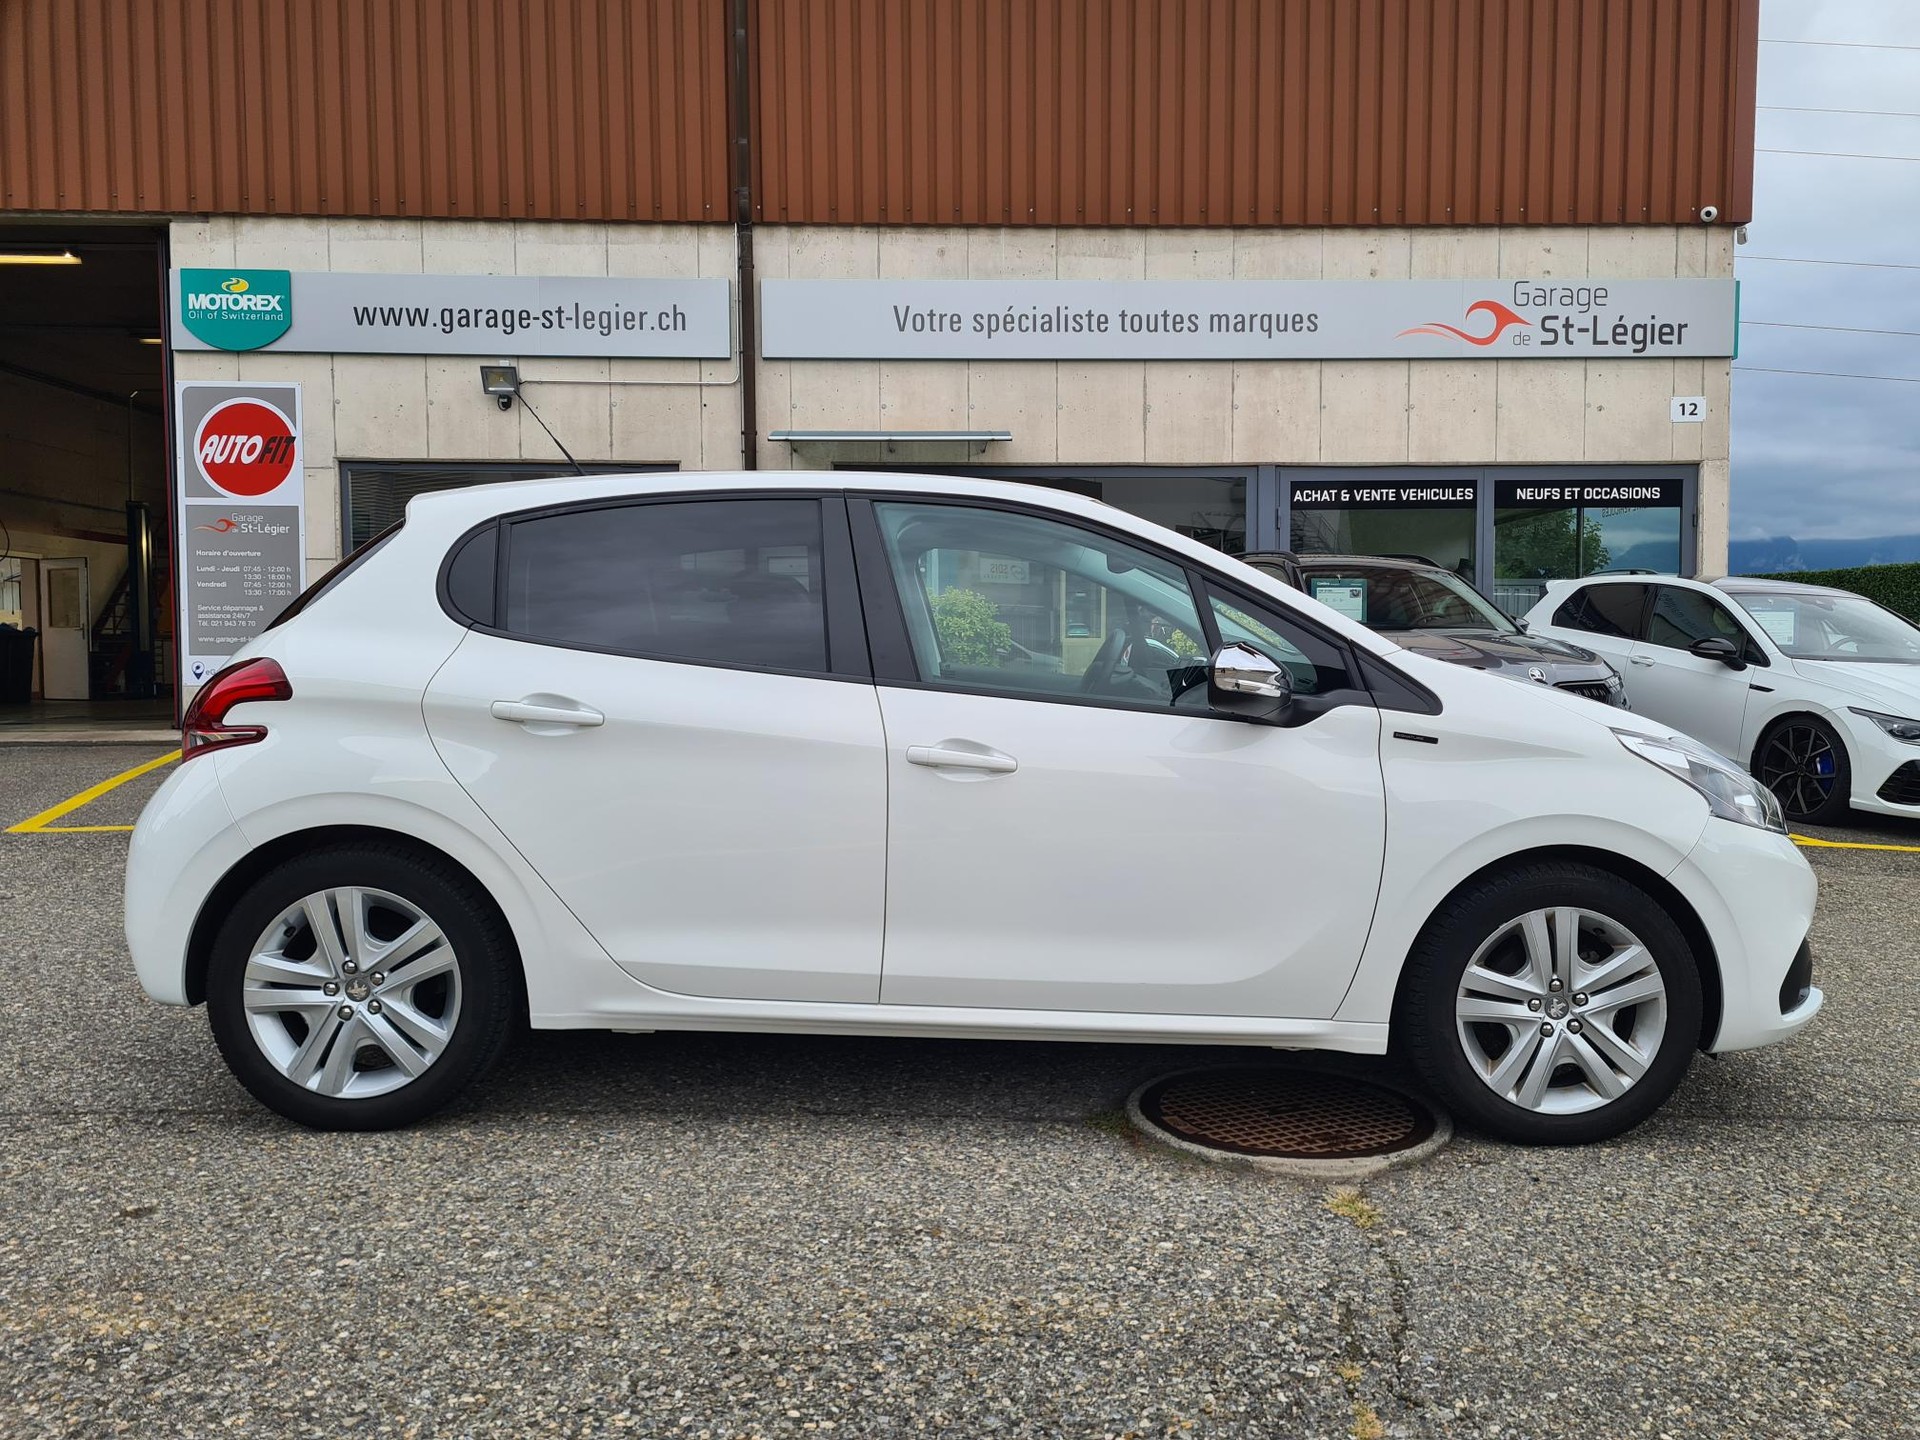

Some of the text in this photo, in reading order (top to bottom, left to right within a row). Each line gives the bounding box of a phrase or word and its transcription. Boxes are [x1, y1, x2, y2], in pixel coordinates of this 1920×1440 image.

[188, 293, 283, 312] MOTOREX
[1512, 280, 1608, 314] Garage
[188, 310, 284, 321] Oil of Switzerland
[352, 302, 687, 336] www.garage-st-legier.ch
[893, 305, 1319, 340] Votre spécialiste toutes marques
[1512, 314, 1689, 354] de St-Légier
[1679, 402, 1698, 416] 12
[200, 434, 297, 465] AUTOFIT
[1293, 488, 1474, 502] ACHAT & VENTE VEHICULES
[1516, 487, 1661, 500] NEUFS ET OCCASIONS
[231, 512, 264, 524] Garage
[241, 523, 290, 536] St-Légier
